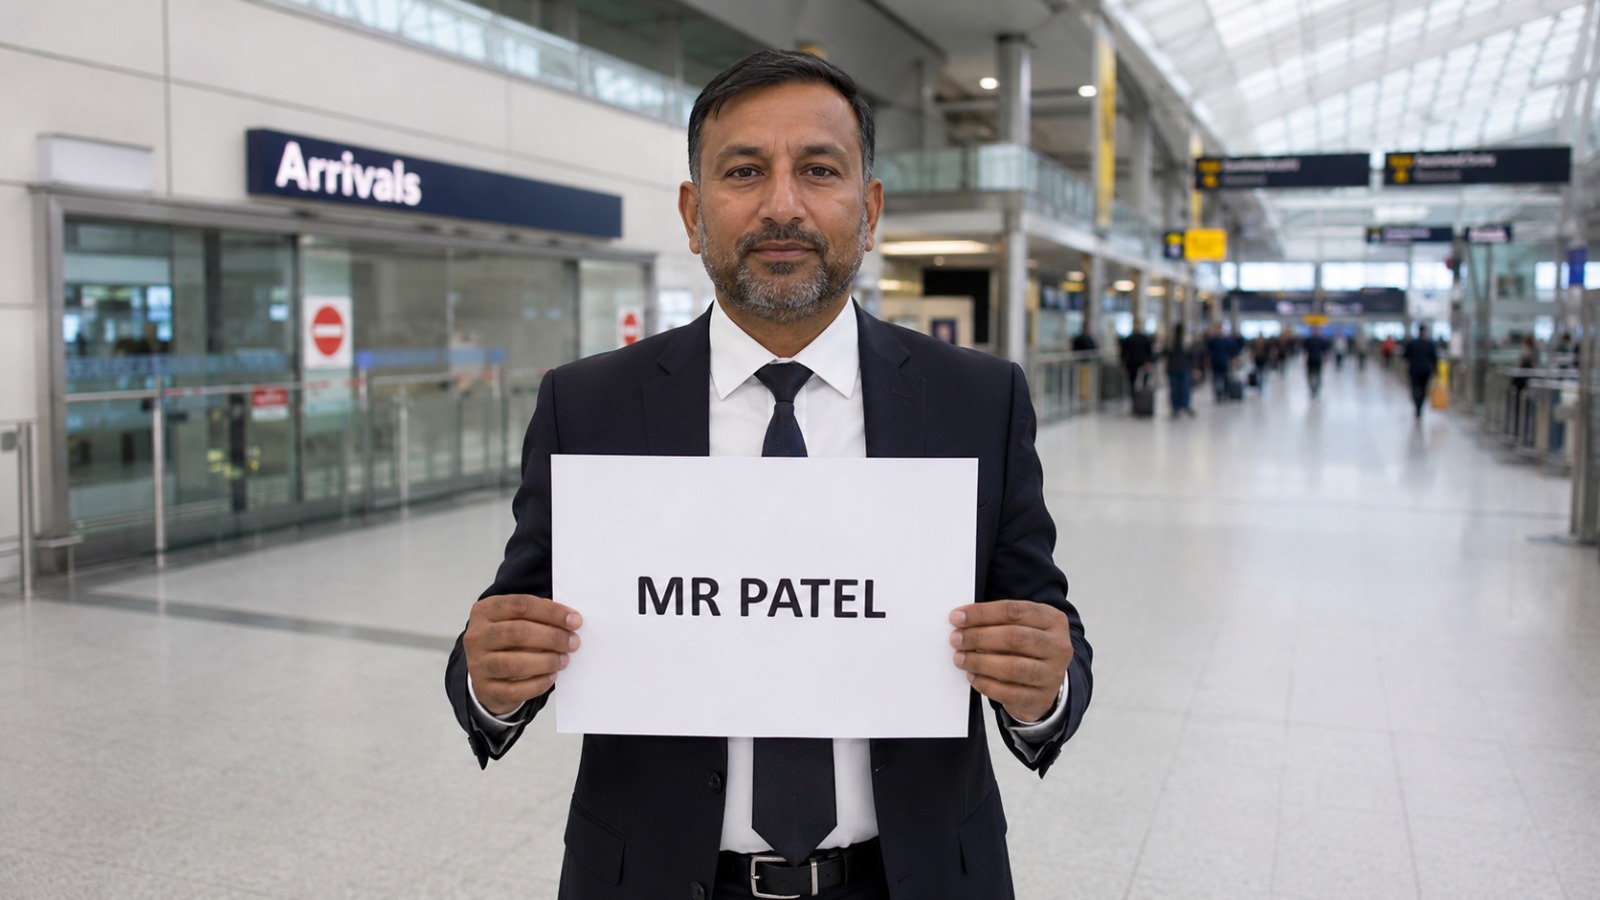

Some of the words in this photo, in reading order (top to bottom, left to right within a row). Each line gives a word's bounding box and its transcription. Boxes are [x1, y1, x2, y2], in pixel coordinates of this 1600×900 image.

[275, 141, 422, 206] Arrivals
[637, 575, 722, 617] MR
[740, 577, 887, 619] PATEL
